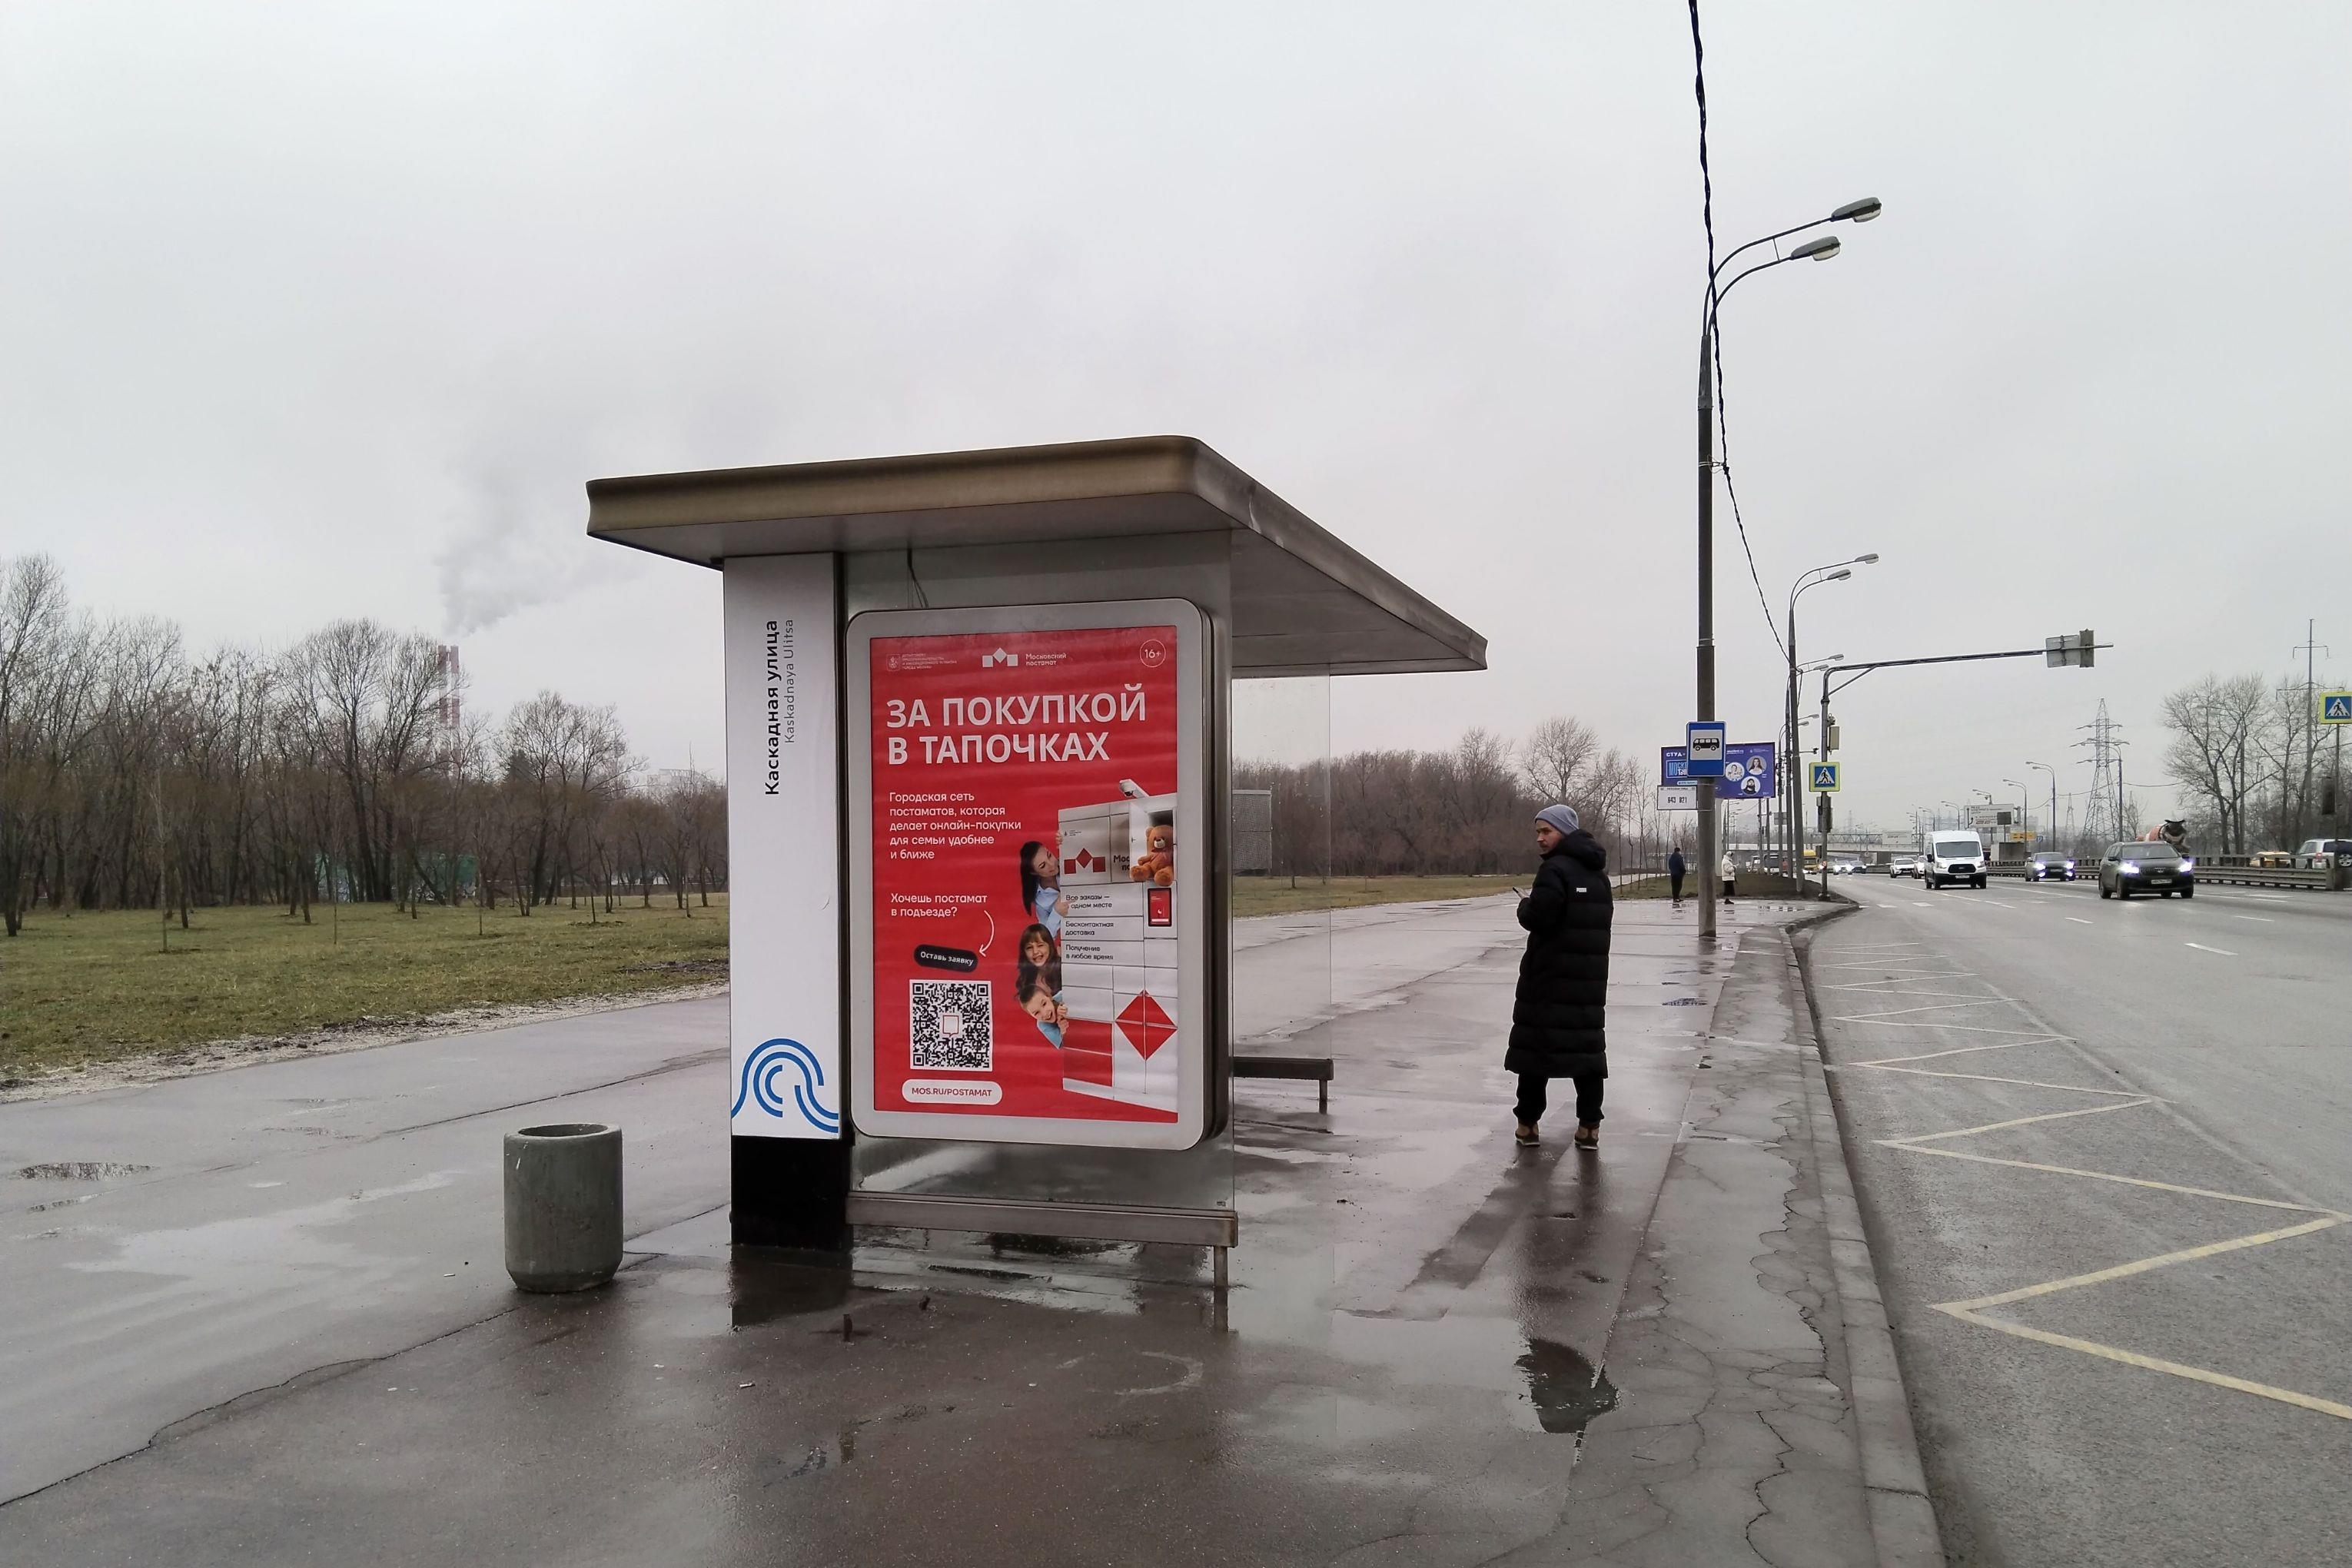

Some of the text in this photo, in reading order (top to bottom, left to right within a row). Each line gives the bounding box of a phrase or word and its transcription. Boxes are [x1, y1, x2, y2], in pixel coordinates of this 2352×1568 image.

[1025, 652, 1067, 660] Московский
[1144, 649, 1161, 659] 16+
[783, 619, 796, 744] Kaskadnaya Ulitsa
[765, 620, 782, 795] Каскадная улица
[886, 683, 1146, 728] ЗА ПОКУПКОЙ
[888, 732, 1111, 765] В ТАПОЧКАХ
[889, 792, 975, 804] Городская сеть
[889, 807, 1005, 817] постаматов, которая
[889, 820, 1022, 832] делает онлайн-покупки
[889, 835, 995, 847] для семьи удобнее
[890, 849, 935, 859] и ближе
[891, 892, 988, 904] Хочешь постамат
[900, 906, 958, 918] подъезде?
[1065, 944, 1101, 952] Получение
[920, 951, 974, 967] Оставь заявку
[912, 1087, 992, 1097] MOS.RU/POSTAMAT
